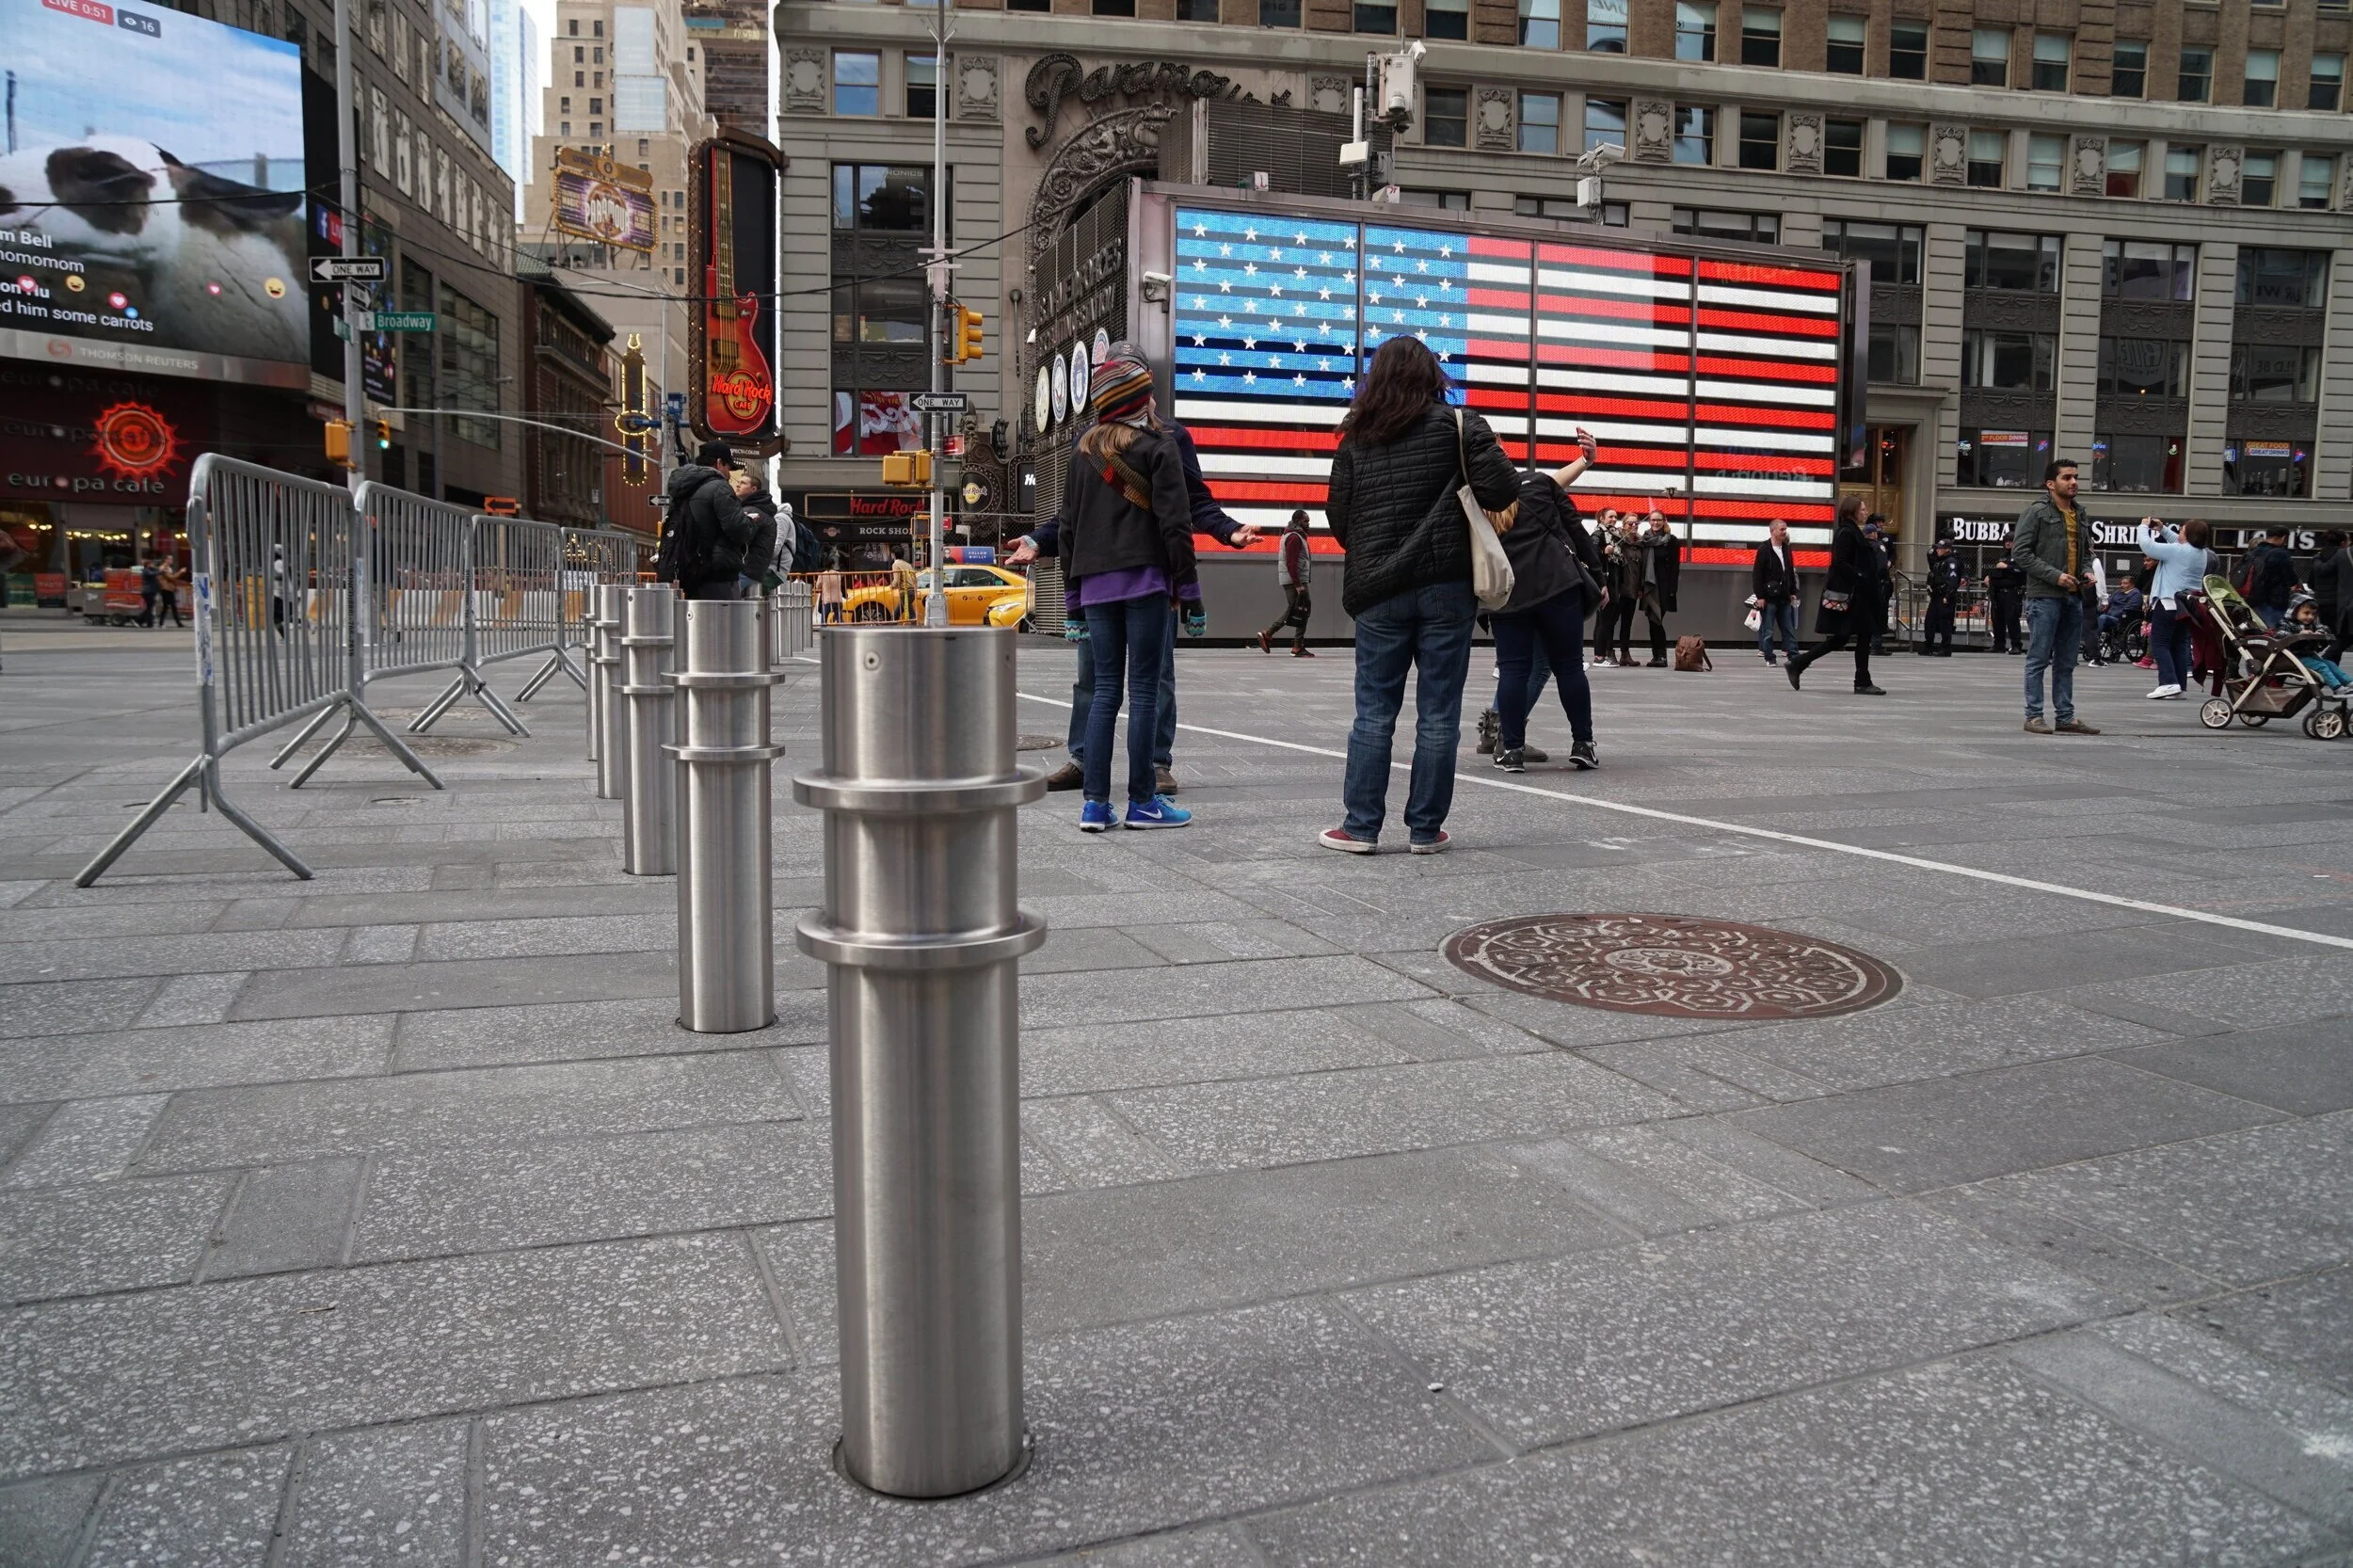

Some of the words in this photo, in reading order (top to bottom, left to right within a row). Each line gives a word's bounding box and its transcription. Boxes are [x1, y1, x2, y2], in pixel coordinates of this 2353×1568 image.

[82, 4, 106, 19] 0:51
[141, 20, 155, 33] 16
[1025, 53, 1292, 148] Paramo
[21, 232, 53, 248] Bell
[332, 265, 354, 275] ONE
[357, 264, 377, 274] WAY
[17, 301, 48, 318] him
[53, 308, 97, 325] some
[101, 314, 153, 331] carrots
[377, 314, 432, 330] Broadway
[80, 347, 142, 364] THOMSON
[146, 355, 199, 370] REUTERS
[712, 374, 743, 396] Hard
[744, 379, 771, 405] Rock
[734, 400, 752, 411] CAFE
[941, 398, 960, 407] WAY
[8, 472, 105, 493] europa
[971, 485, 988, 496] Rock
[850, 497, 888, 516] Hard
[889, 498, 926, 517] Rock
[859, 526, 886, 536] ROCK
[888, 526, 912, 536] SHO
